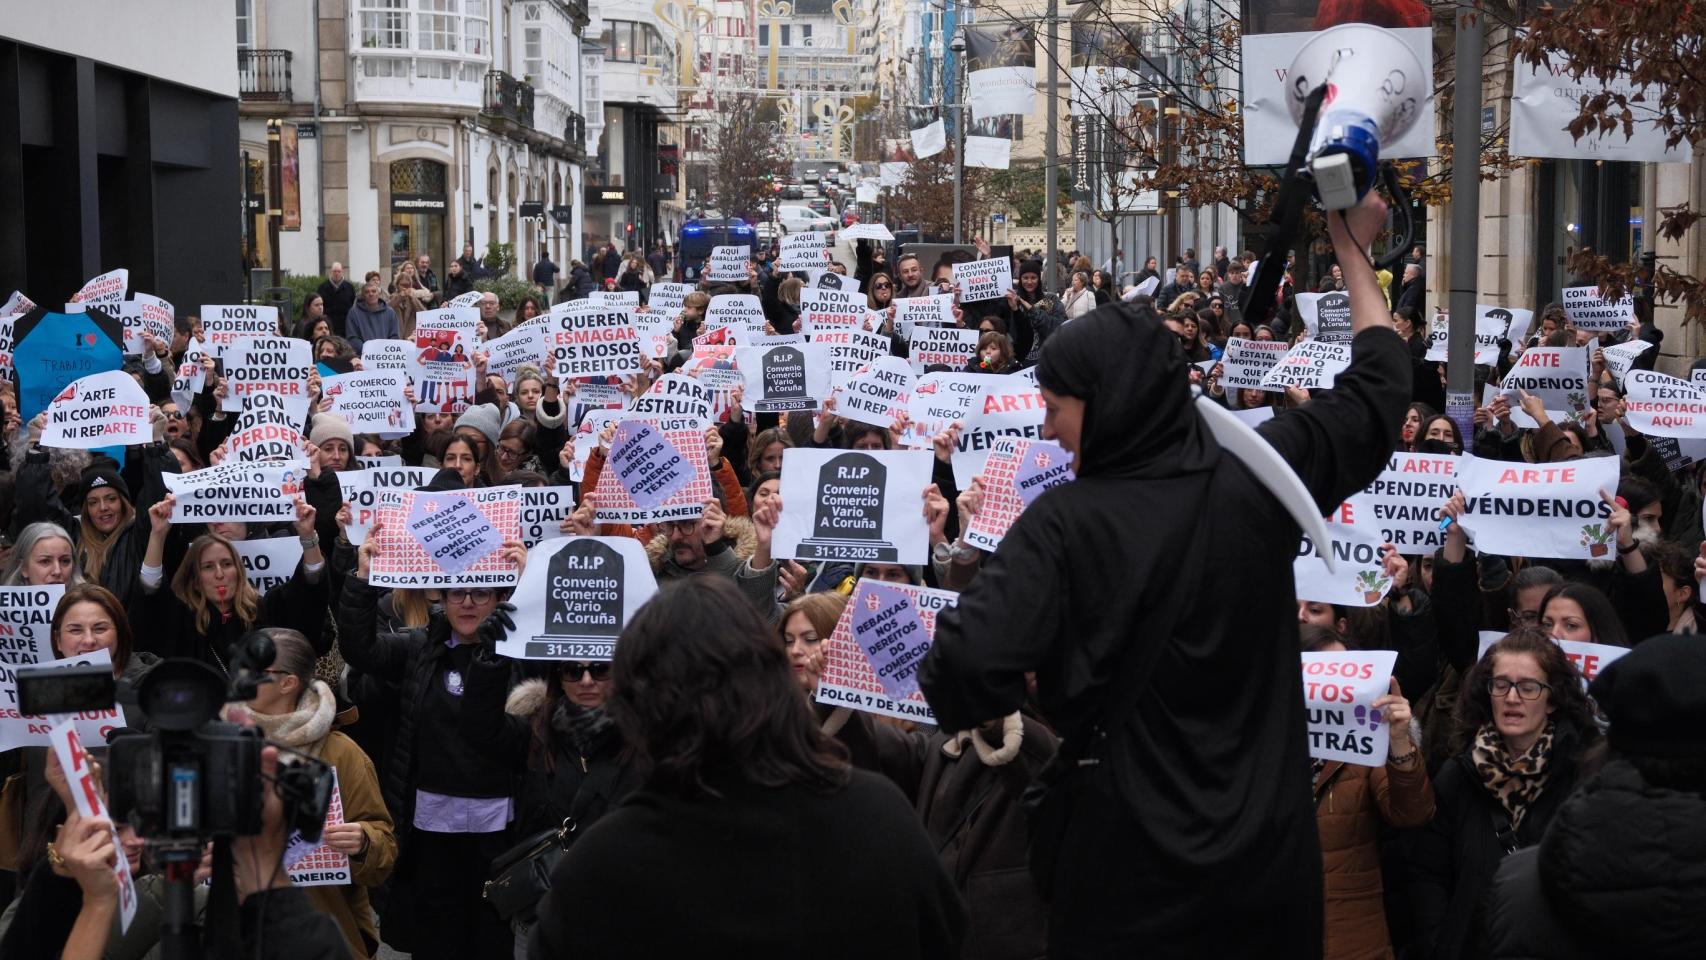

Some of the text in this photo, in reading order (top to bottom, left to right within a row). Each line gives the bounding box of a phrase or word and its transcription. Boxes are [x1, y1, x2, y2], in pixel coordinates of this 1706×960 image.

[794, 234, 815, 242] AQUÍ
[781, 261, 827, 269] NEGOCIAMOS
[959, 260, 1003, 271] CONVENIO
[81, 277, 121, 293] CONVENIO
[78, 283, 124, 301] PROVINCIAL
[819, 292, 849, 303] NON
[965, 290, 1000, 300] ESTATAL
[1566, 290, 1586, 298] CON
[159, 301, 169, 310] DO
[802, 303, 866, 314] PODEMOS
[1326, 299, 1343, 307] R.I.P
[222, 308, 257, 319] NON
[809, 314, 857, 325] PERDER
[1574, 310, 1618, 318] LEVAMOS
[204, 321, 277, 332] PODEMOS
[561, 312, 629, 330] QUEREN
[1327, 320, 1351, 328] Coruña
[555, 327, 636, 345] ESMAGAR
[928, 330, 960, 340] NON
[1320, 334, 1353, 342] 31-12-2025
[254, 340, 291, 349] NON
[495, 336, 533, 351] COMERCIO
[816, 333, 887, 351] ARTE PARA
[912, 340, 976, 353] PODEMOS
[1231, 339, 1288, 351] UN CONVENIO
[504, 347, 526, 358] TÉXTIL
[555, 347, 576, 360] OS
[579, 342, 640, 358] NOSOS
[1240, 351, 1277, 360] ESTATAL
[246, 352, 287, 365] NON
[491, 353, 539, 370] NEGOCIACIÓN
[774, 354, 792, 362] R.I.P
[918, 352, 968, 364] PERDER
[1230, 358, 1260, 367] MOITO
[1520, 353, 1560, 368] ARTE
[559, 357, 640, 374] DEREITOS
[226, 367, 309, 381] PODEMOS
[874, 372, 907, 386] ARTE
[1243, 369, 1261, 377] QUE
[234, 383, 299, 395] PERDER
[350, 378, 397, 387] COMERCIO
[775, 384, 802, 392] Coruña
[1501, 376, 1584, 390] VÉNDENOS
[83, 388, 116, 402] ARTE
[359, 389, 388, 398] TÉXTIL
[1650, 386, 1701, 400] TÉXTIL
[242, 394, 284, 413] NON
[340, 399, 401, 410] NEGOCIACIÓN
[766, 402, 806, 410] 31-12-2025
[848, 396, 862, 408] NI
[53, 406, 143, 423] NI COMPARTE
[358, 412, 386, 421] AQUI!!
[660, 419, 687, 431] UGT
[1651, 416, 1693, 428] AQUI!
[62, 422, 137, 439] NI REPARTE
[232, 426, 298, 451] PERDER
[240, 442, 294, 462] NADA
[612, 427, 651, 464] REBAIXAS
[625, 444, 644, 462] NOS
[620, 443, 664, 479] DEREITOS
[184, 461, 286, 484] NEGOCIADES
[638, 461, 655, 475] DO
[838, 466, 870, 479] R.I.P
[1403, 459, 1458, 477] ARTE,
[177, 471, 209, 480] POR
[254, 473, 264, 483] O
[373, 471, 423, 488] NON
[630, 455, 681, 495] COMERCIO
[1498, 468, 1576, 484] ARTE
[194, 486, 282, 499] CONVENIO
[823, 484, 880, 496] Convenio
[477, 491, 505, 503] UGT
[822, 495, 879, 507] Comercio
[183, 503, 293, 516] PROVINCIAL?
[832, 507, 864, 518] Vario
[1464, 494, 1610, 520] VÉNDENOS
[412, 500, 467, 530] REBAIXAS
[631, 511, 648, 521] DE
[423, 513, 477, 543] DEREITOS
[433, 515, 457, 529] NOS
[820, 516, 877, 529] A Coruña
[447, 529, 465, 540] DO
[435, 525, 491, 559] COMERCIO
[814, 546, 879, 559] 31-12-2025
[568, 556, 604, 569] R.I.P
[372, 574, 516, 585] FOLGA 7 DE XANEIRO
[554, 576, 618, 588] Convenio
[552, 589, 618, 600] Comercio
[565, 601, 601, 611] Vario
[552, 612, 616, 624] A Coruña
[856, 599, 909, 636] REBAIXAS
[875, 619, 899, 638] NOS
[868, 621, 918, 657] DEREITOS
[889, 642, 905, 657] DO
[878, 641, 930, 678] COMERCIO
[820, 688, 894, 711] FOLGA 7 DE
[1310, 729, 1374, 755] TRÁS
